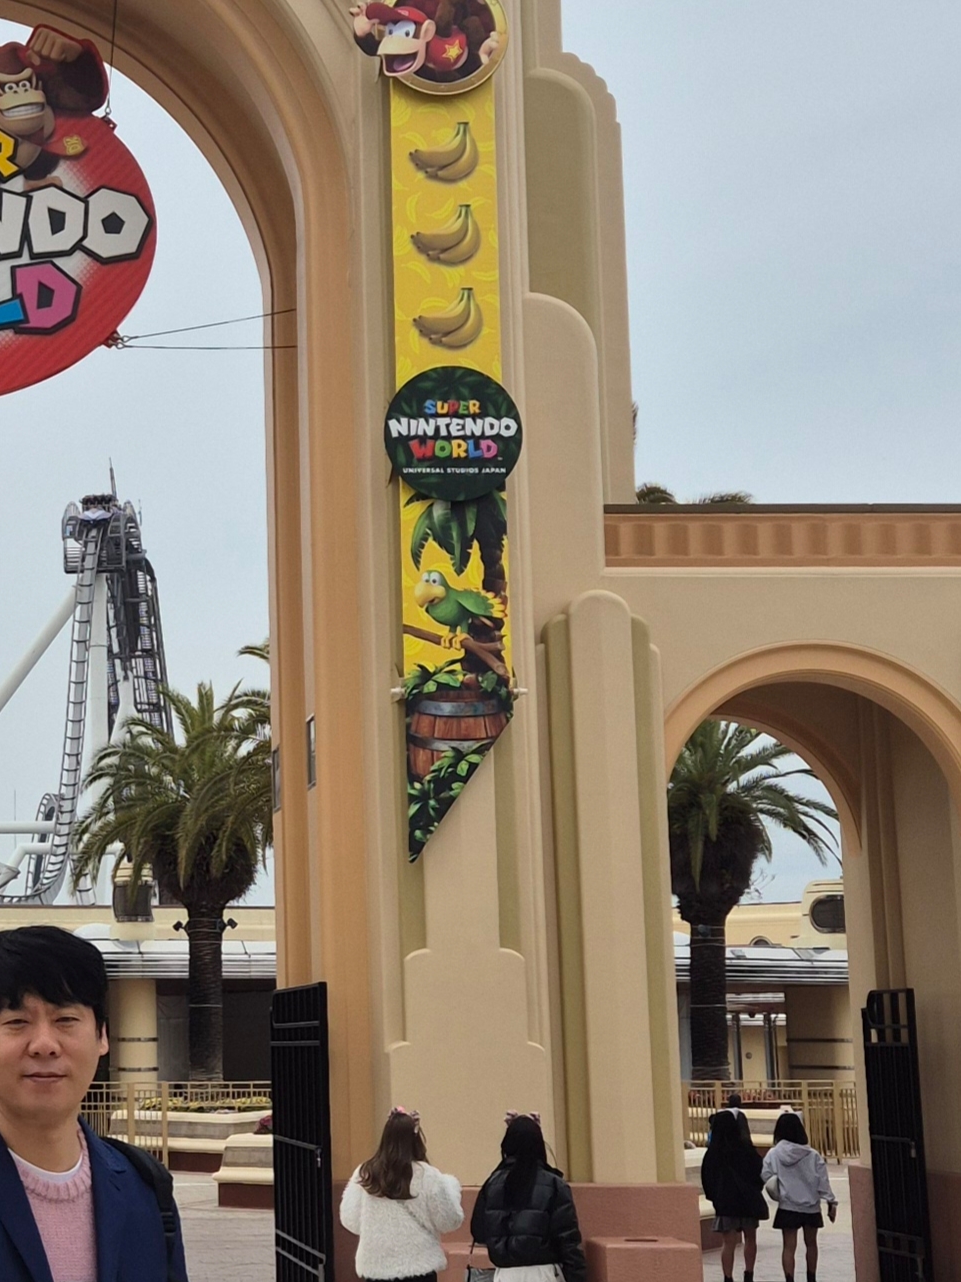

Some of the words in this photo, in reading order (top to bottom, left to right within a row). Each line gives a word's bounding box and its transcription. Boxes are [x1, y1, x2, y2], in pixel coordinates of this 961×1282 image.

[423, 399, 481, 415] SUPER
[387, 417, 519, 438] NINTENDO
[408, 438, 499, 460] WORLD
